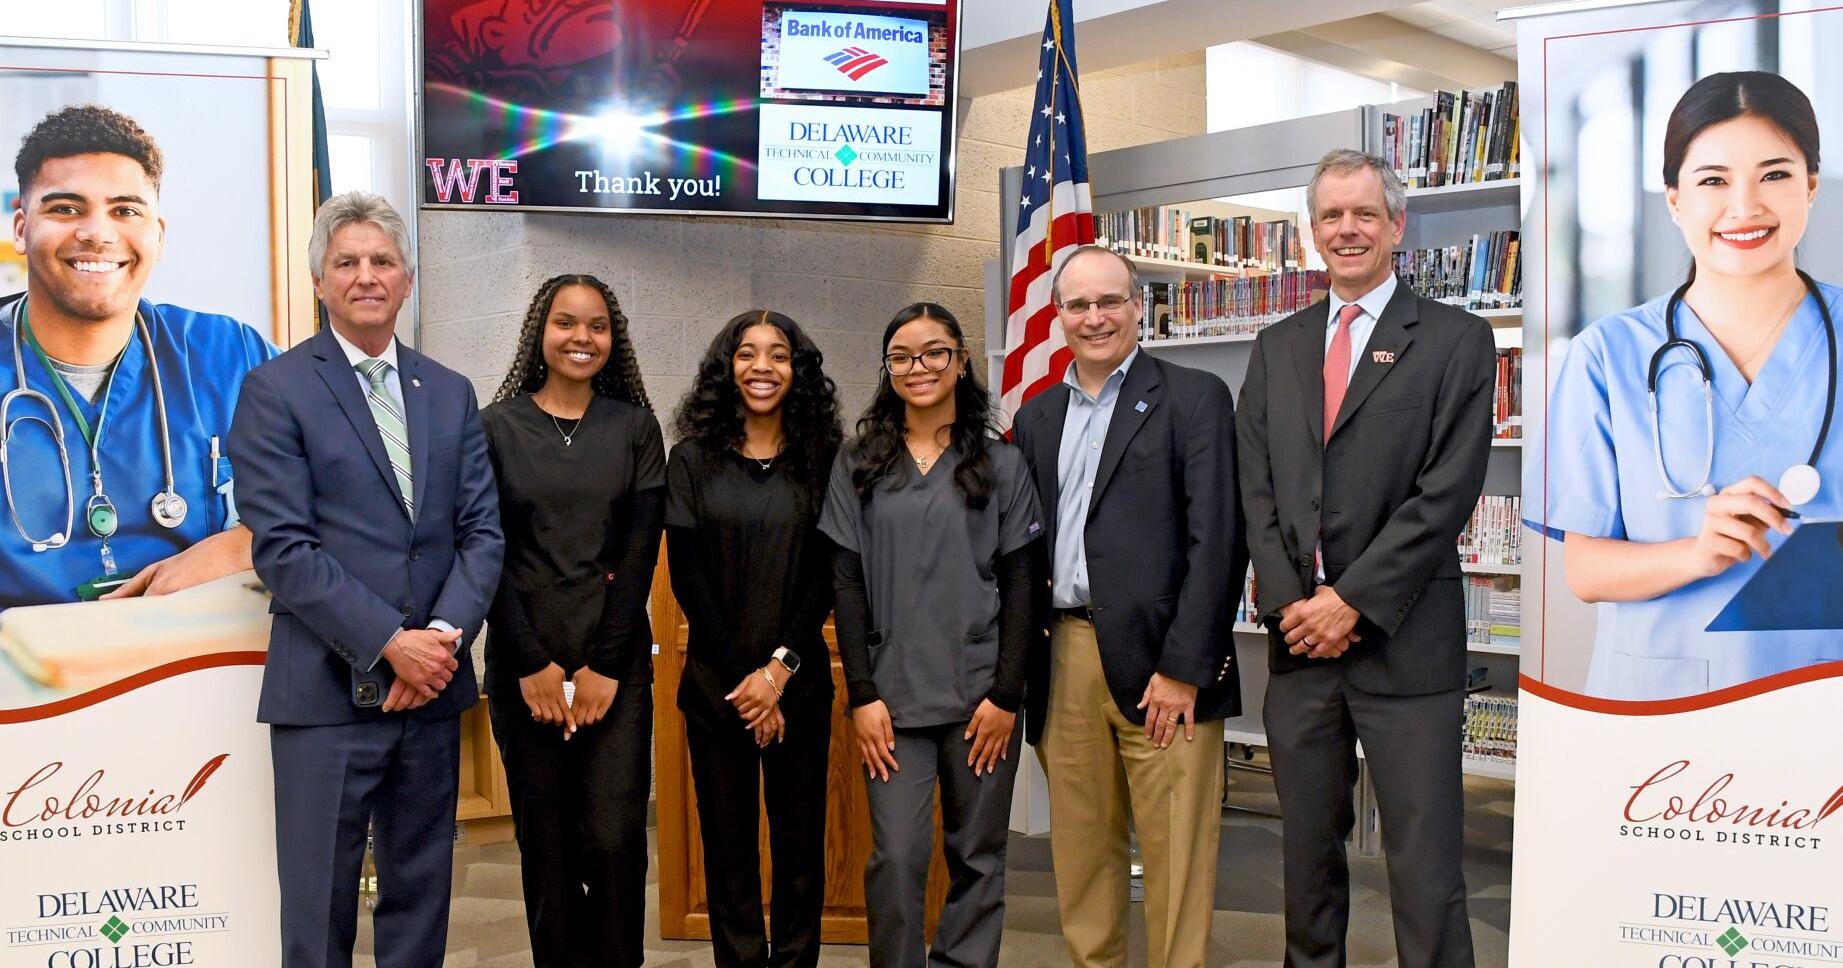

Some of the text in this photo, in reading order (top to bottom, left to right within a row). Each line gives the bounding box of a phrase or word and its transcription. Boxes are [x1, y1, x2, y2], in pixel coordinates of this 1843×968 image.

[787, 19, 923, 44] Bank of America
[789, 121, 913, 145] DELAWARE
[766, 147, 934, 164] TECHNICAL COMMUNITY
[426, 158, 519, 203] WE
[574, 170, 721, 201] Thank you!
[794, 166, 905, 189] COLLEGE
[1372, 351, 1394, 363] WE
[2, 753, 232, 827] Colonial
[1623, 760, 1843, 830] Colonial
[0, 819, 186, 841] SCHOOL DISTRICT
[1620, 825, 1821, 849] SCHOOL DISTRICT
[37, 884, 200, 918] DELAWARE
[1652, 892, 1829, 933] DELAWARE
[7, 915, 229, 944] TECHNICAL COMMUNITY
[1619, 926, 1714, 946] TECHNICAL
[48, 941, 194, 968] COLLEGE
